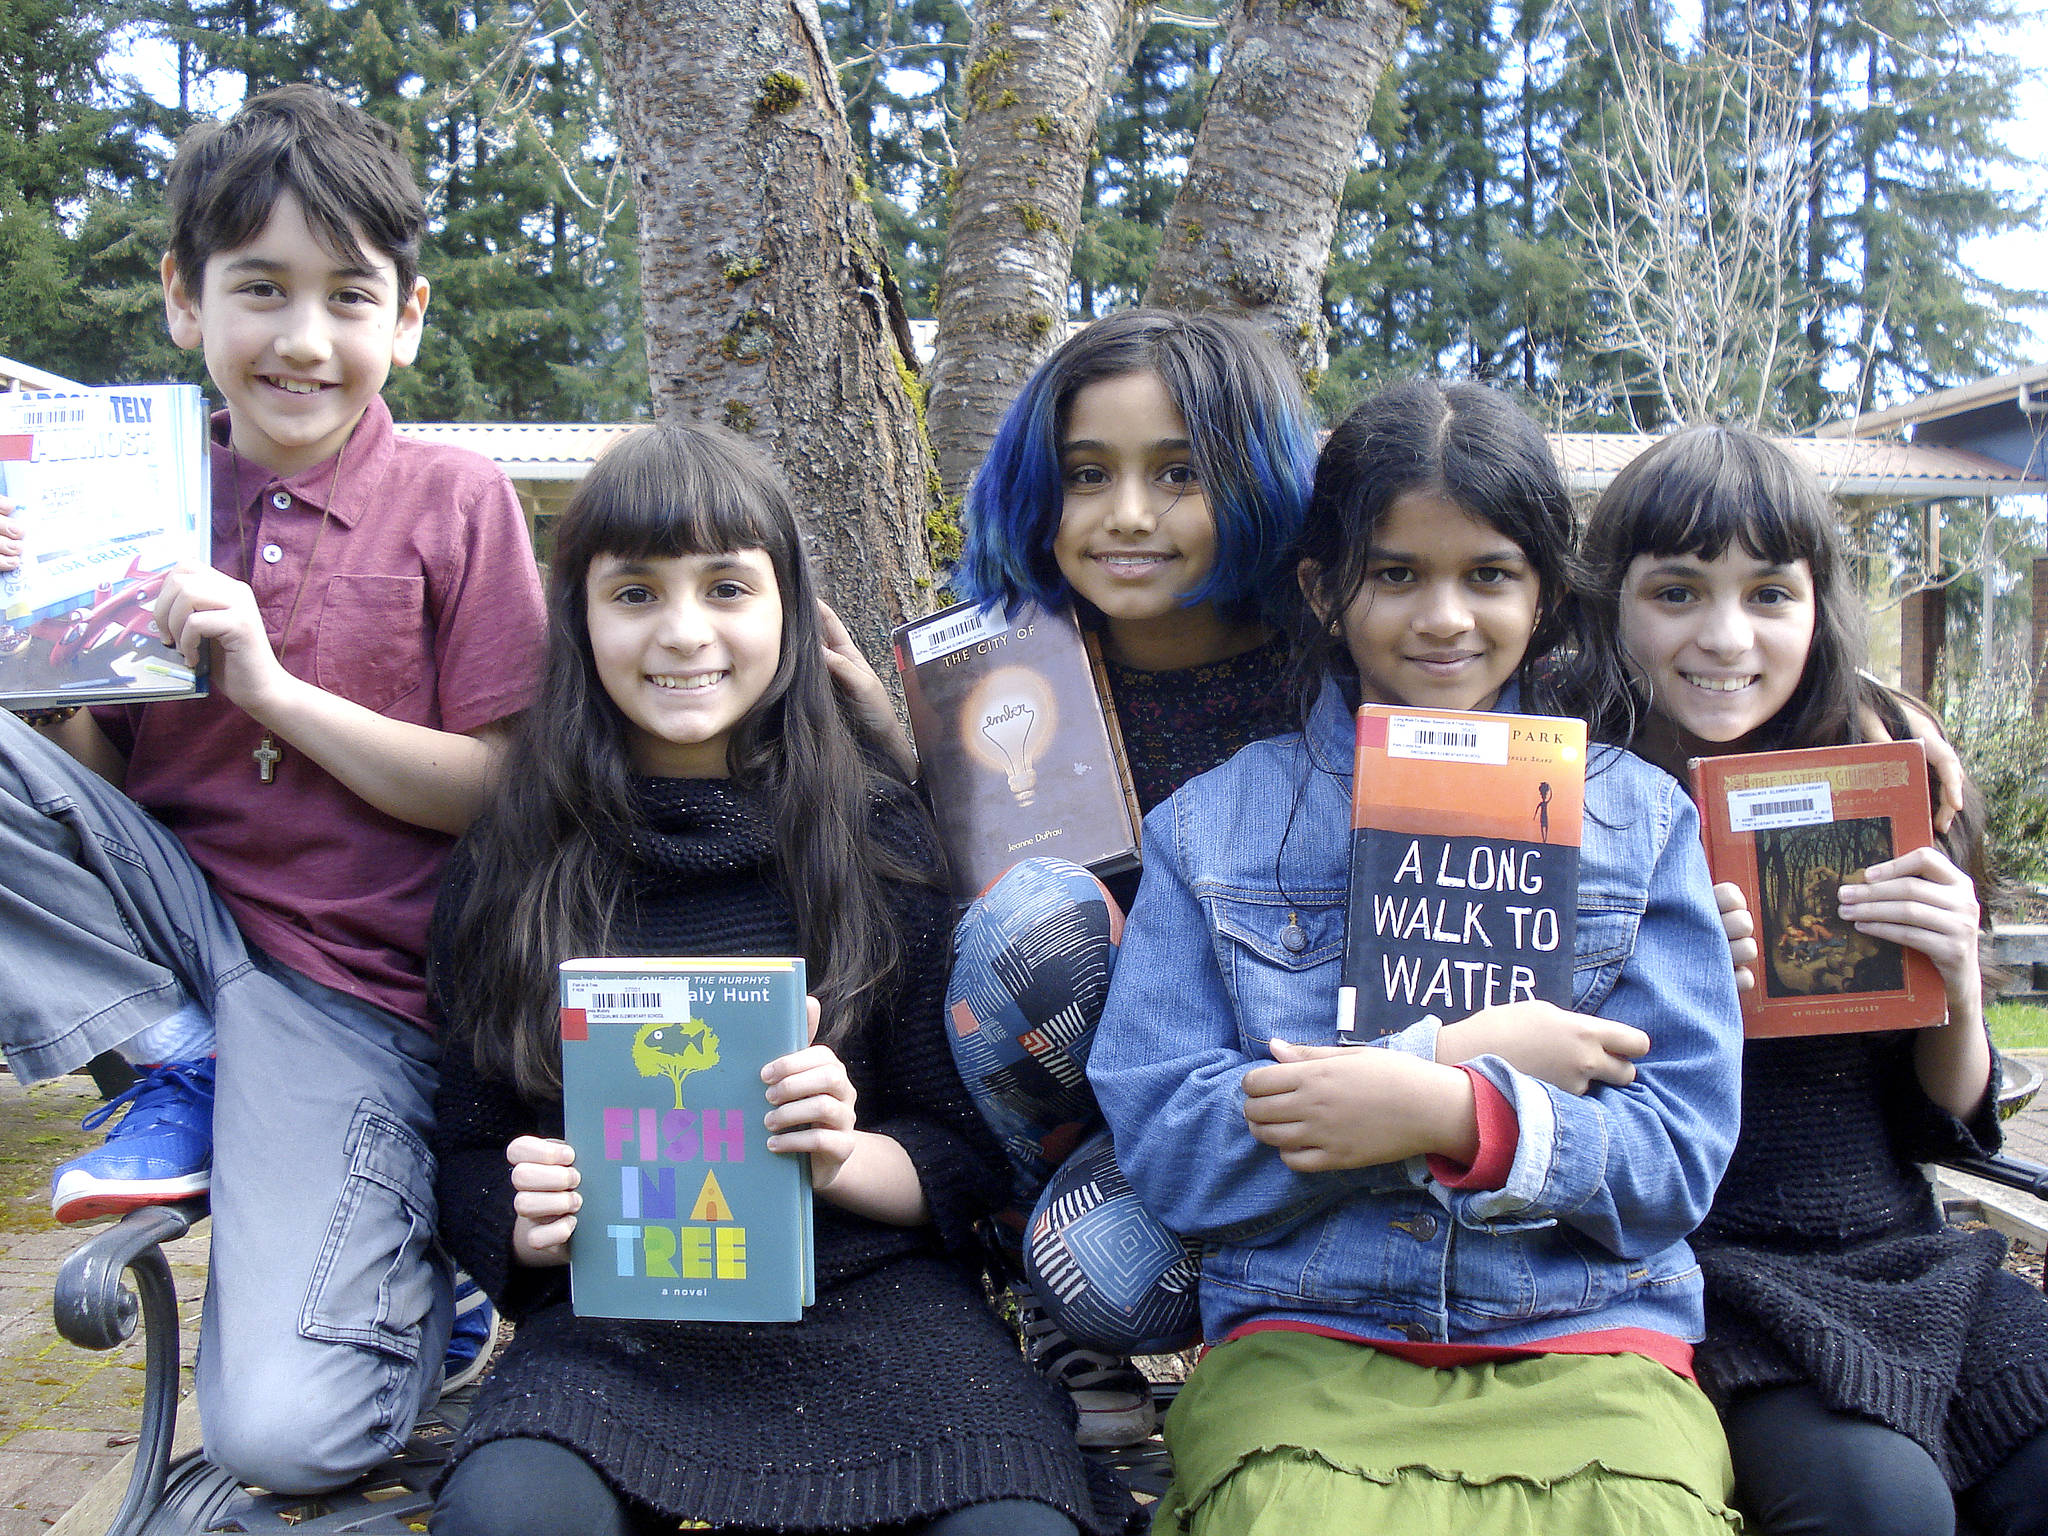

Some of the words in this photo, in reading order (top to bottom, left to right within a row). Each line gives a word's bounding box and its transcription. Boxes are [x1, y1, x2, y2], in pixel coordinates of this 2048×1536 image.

[943, 649, 970, 667] THE
[977, 634, 1008, 655] CITY
[1016, 625, 1034, 640] OF
[1512, 730, 1564, 744] PARK
[1008, 838, 1034, 853] Jeanne
[1035, 828, 1063, 843] DuPrau
[1393, 840, 1423, 884] A
[1436, 843, 1543, 895] LONG
[1374, 894, 1493, 948] WALK
[1506, 907, 1560, 951] TO
[695, 976, 715, 985] THE
[718, 976, 771, 985] MURPHYS
[724, 987, 770, 1002] Hunt
[1382, 954, 1537, 1011] WATER
[604, 1107, 745, 1163] FISH
[621, 1166, 676, 1219] IN
[690, 1169, 734, 1221] A
[607, 1225, 747, 1280] TREE
[661, 1289, 669, 1297] a
[674, 1286, 708, 1297] novel
